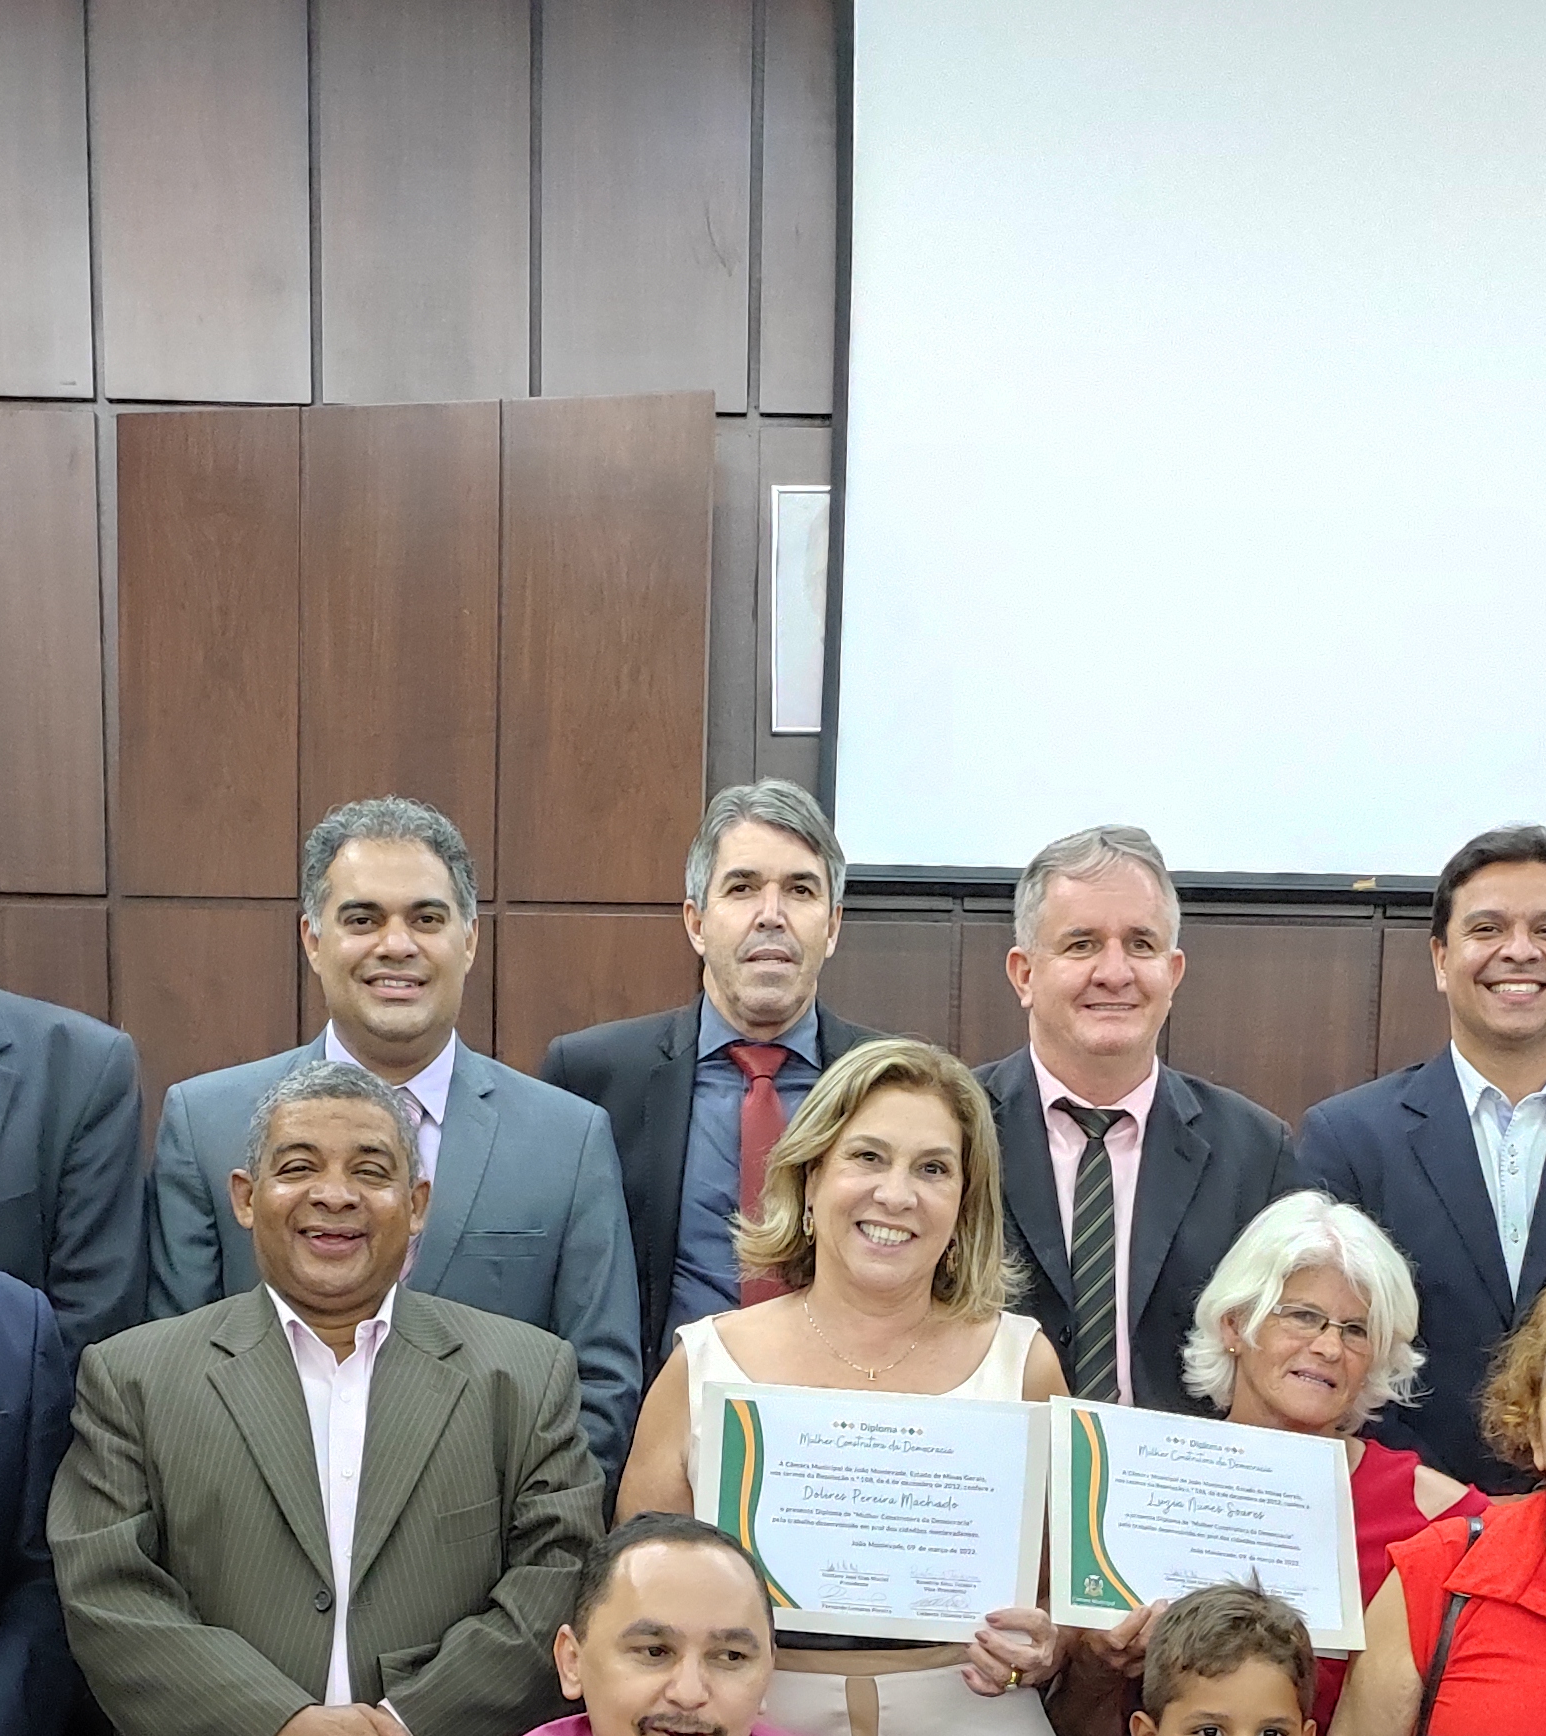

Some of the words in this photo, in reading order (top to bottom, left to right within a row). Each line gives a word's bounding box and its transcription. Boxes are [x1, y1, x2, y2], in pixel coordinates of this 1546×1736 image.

[860, 1422, 898, 1434] Diploma
[1189, 1439, 1223, 1451] Diploma
[802, 1484, 846, 1503] Dolores
[851, 1488, 897, 1507] Pereira
[900, 1491, 958, 1513] Machado
